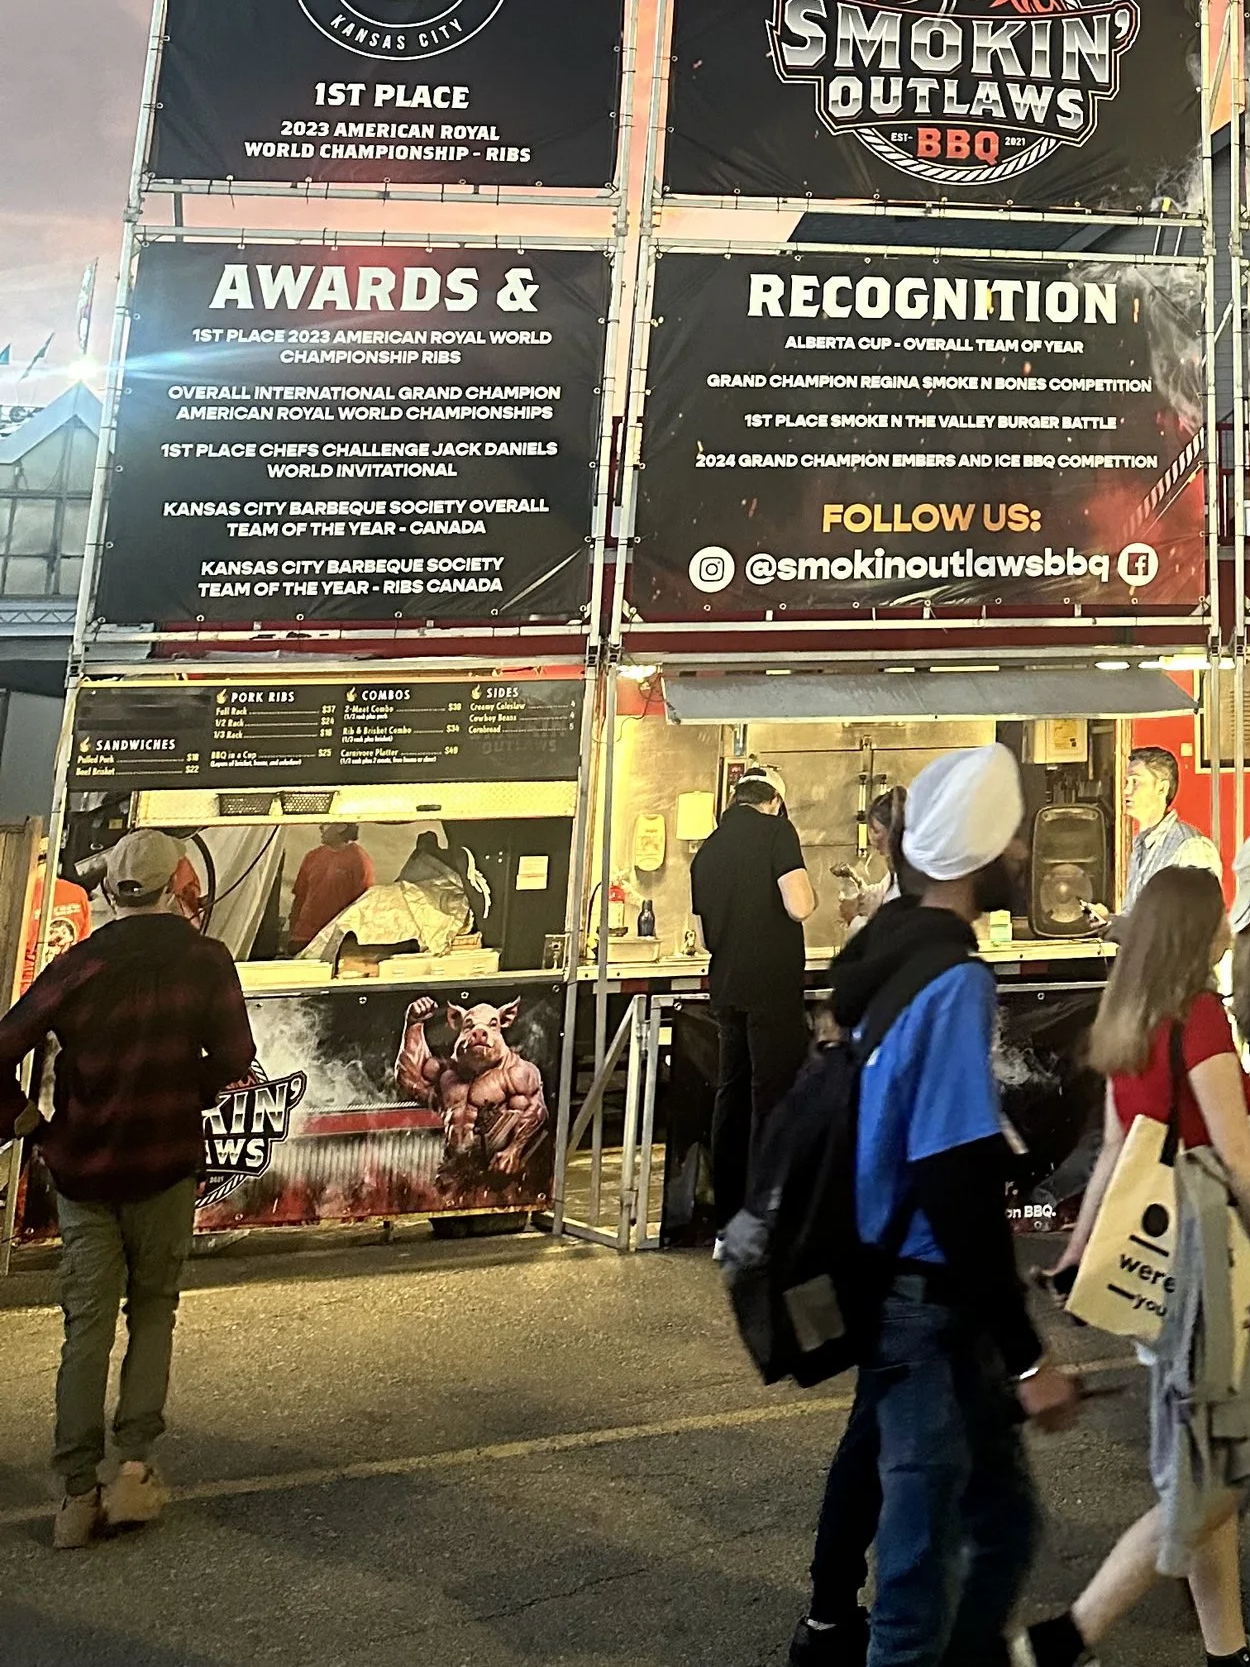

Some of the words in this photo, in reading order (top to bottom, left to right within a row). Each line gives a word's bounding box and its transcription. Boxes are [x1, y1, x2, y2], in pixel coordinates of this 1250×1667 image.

[330, 14, 405, 50] KANSAS
[418, 18, 462, 48] CITY
[314, 82, 367, 106] 1ST
[373, 83, 470, 109] PLACE
[827, 76, 1085, 128] OUTLAWS
[280, 120, 330, 137] 2023
[333, 122, 435, 139] AMERICAN
[440, 124, 500, 141] ROYAL
[244, 141, 315, 159] WORLD
[319, 143, 470, 161] CHAMPIONSHIP
[485, 146, 531, 163] RIBS
[917, 127, 1000, 166] BBQ
[1004, 136, 1026, 146] 2021
[208, 261, 480, 312] AWARDS
[496, 268, 540, 312] &
[747, 273, 1119, 325] RECOGNITION
[192, 328, 224, 342] 1ST
[226, 329, 285, 343] PLACE
[288, 329, 331, 344] 2023
[333, 330, 428, 344] AMERICAN
[430, 330, 487, 345] ROYAL
[488, 330, 553, 345] WORLD
[784, 335, 856, 350] ALBERTA
[857, 336, 893, 350] CUP
[903, 337, 974, 352] OVERALL
[975, 338, 1019, 353] TEAM
[1020, 339, 1043, 353] OF
[1043, 339, 1084, 354] YEAR
[280, 349, 420, 364] CHAMPIONSHIP
[421, 350, 462, 364] RIBS
[706, 373, 767, 388] GRAND
[769, 374, 858, 389] CHAMPION
[860, 375, 921, 390] REGINA
[922, 375, 979, 391] SMOKE
[980, 376, 993, 390] N
[994, 377, 1048, 391] BONES
[1048, 377, 1152, 393] COMPETITION
[168, 385, 251, 400] OVERALL
[254, 386, 396, 401] INTERNATIONAL
[397, 386, 463, 401] GRAND
[465, 385, 561, 400] CHAMPION
[175, 406, 274, 421] AMERICAN
[276, 406, 335, 421] ROYAL
[337, 406, 404, 421] WORLD
[405, 405, 554, 421] CHAMPIONSHIPS
[744, 413, 773, 428] 1ST
[774, 413, 829, 428] PLACE
[830, 414, 889, 428] SMOKE
[890, 414, 903, 428] N
[904, 414, 937, 428] THE
[937, 414, 996, 429] VALLEY
[997, 415, 1060, 429] BURGER
[1061, 416, 1117, 430] BATTLE
[160, 443, 194, 458] 1ST
[195, 443, 257, 458] PLACE
[258, 443, 320, 458] CHEFS
[321, 442, 430, 458] CHALLENGE
[431, 442, 482, 457] JACK
[484, 441, 558, 456] DANIELS
[266, 463, 334, 479] WORLD
[336, 462, 458, 478] INVITATIONAL
[695, 452, 736, 468] 2024
[737, 453, 799, 468] GRAND
[800, 453, 890, 468] CHAMPION
[891, 453, 957, 468] EMBERS
[957, 453, 993, 468] AND
[994, 453, 1021, 468] ICE
[1022, 454, 1056, 470] BBQ
[163, 501, 241, 517] KANSAS
[243, 501, 288, 516] CITY
[288, 500, 387, 517] BARBEQUE
[388, 499, 468, 515] SOCIETY
[468, 498, 550, 514] OVERALL
[822, 503, 976, 533] FOLLOW
[983, 503, 1042, 532] US:
[226, 522, 279, 537] TEAM
[281, 522, 308, 537] OF
[309, 521, 346, 536] THE
[348, 521, 397, 536] YEAR
[409, 519, 487, 536] CANADA
[201, 560, 279, 576] KANSAS
[281, 559, 325, 575] CITY
[326, 558, 425, 575] BARBEQUE
[426, 556, 505, 573] SOCIETY
[745, 543, 1113, 588] @smokinoutlawsbbq
[197, 582, 251, 598] TEAM
[253, 581, 280, 597] OF
[282, 581, 319, 596] THE
[320, 580, 370, 596] YEAR
[383, 579, 424, 594] RIBS
[426, 577, 504, 593] CANADA
[230, 691, 264, 703] PORK
[268, 691, 295, 702] RIBS
[361, 689, 411, 701] COMBOS
[486, 687, 519, 698] SIDES
[95, 738, 176, 751] SANDWICHES
[1023, 1203, 1057, 1218] BBQ.
